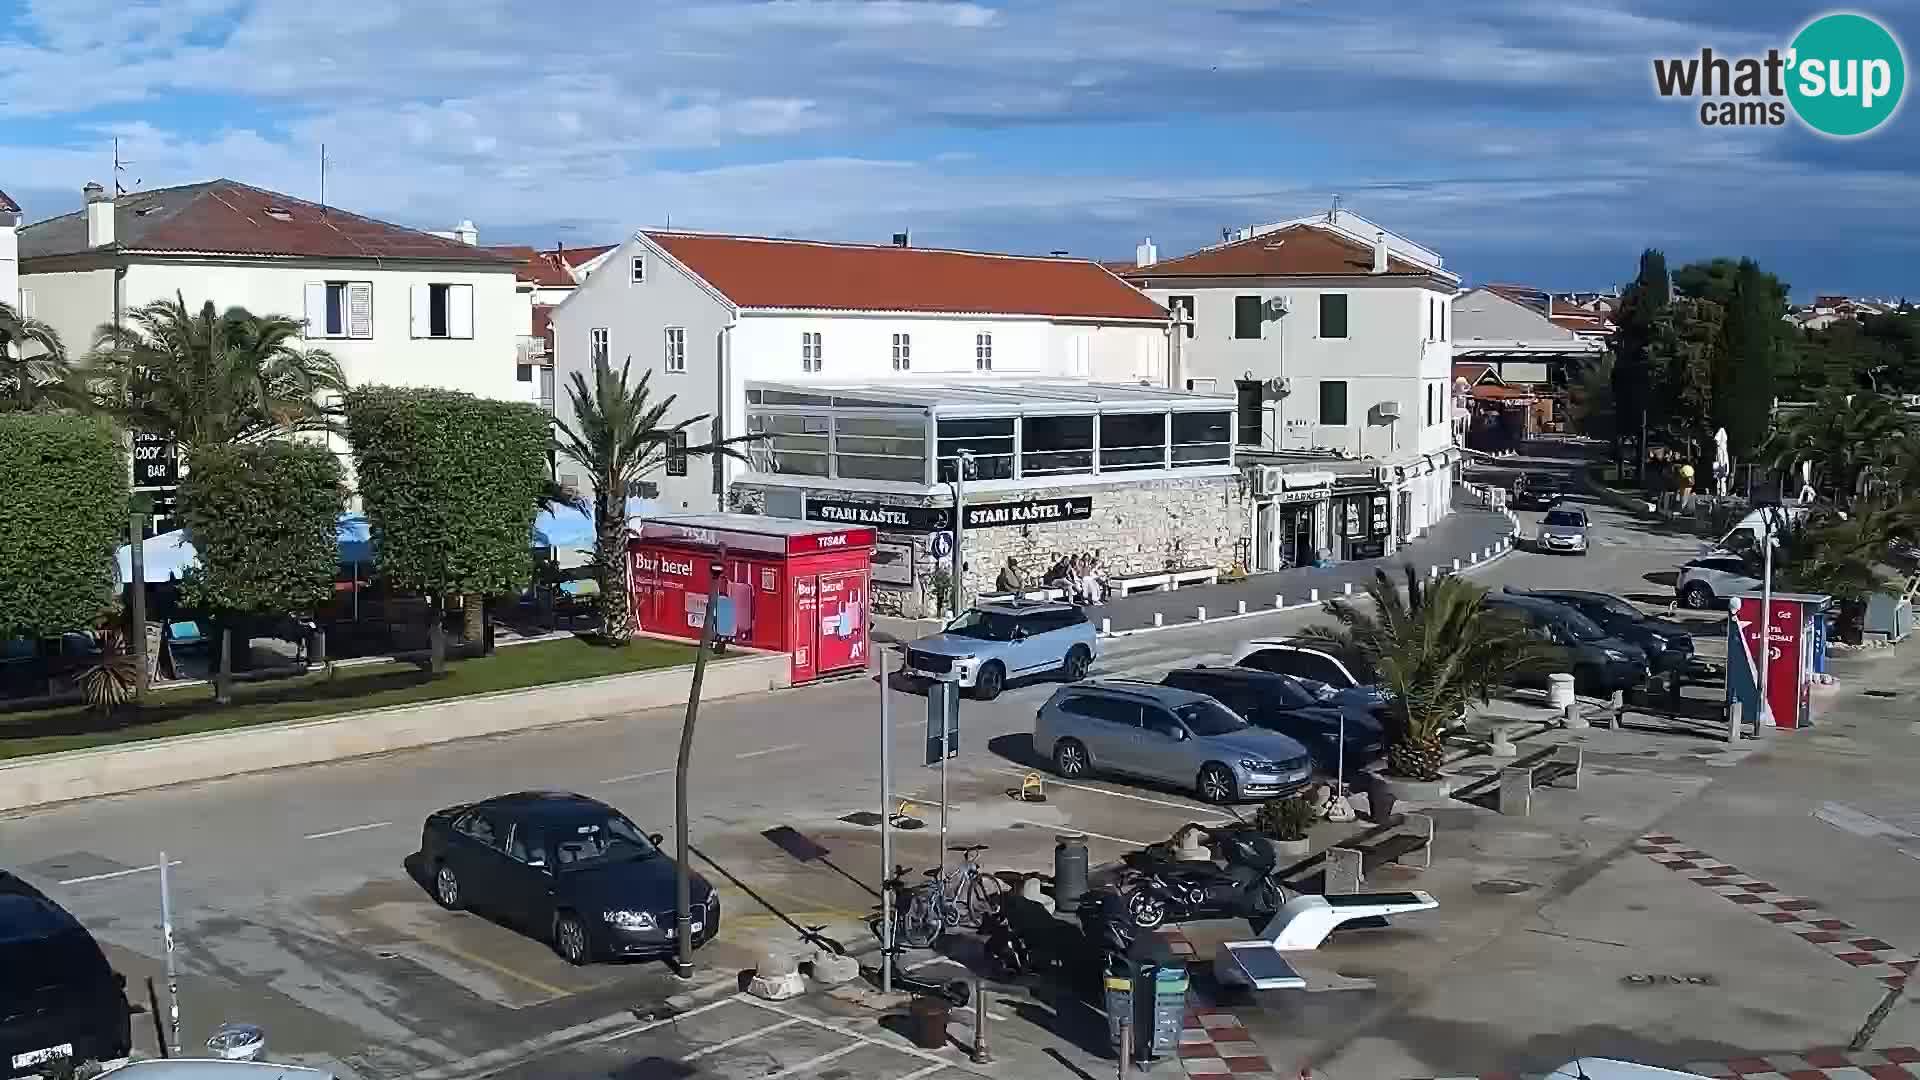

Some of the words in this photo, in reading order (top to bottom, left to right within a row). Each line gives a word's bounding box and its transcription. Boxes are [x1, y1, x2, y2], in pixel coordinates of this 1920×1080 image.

[147, 464, 166, 478] BAR
[821, 506, 857, 521] STARI
[970, 508, 1009, 524] STARI
[1012, 502, 1061, 521] KAŠTEL
[818, 535, 847, 548] TISAK
[661, 556, 693, 577] here!
